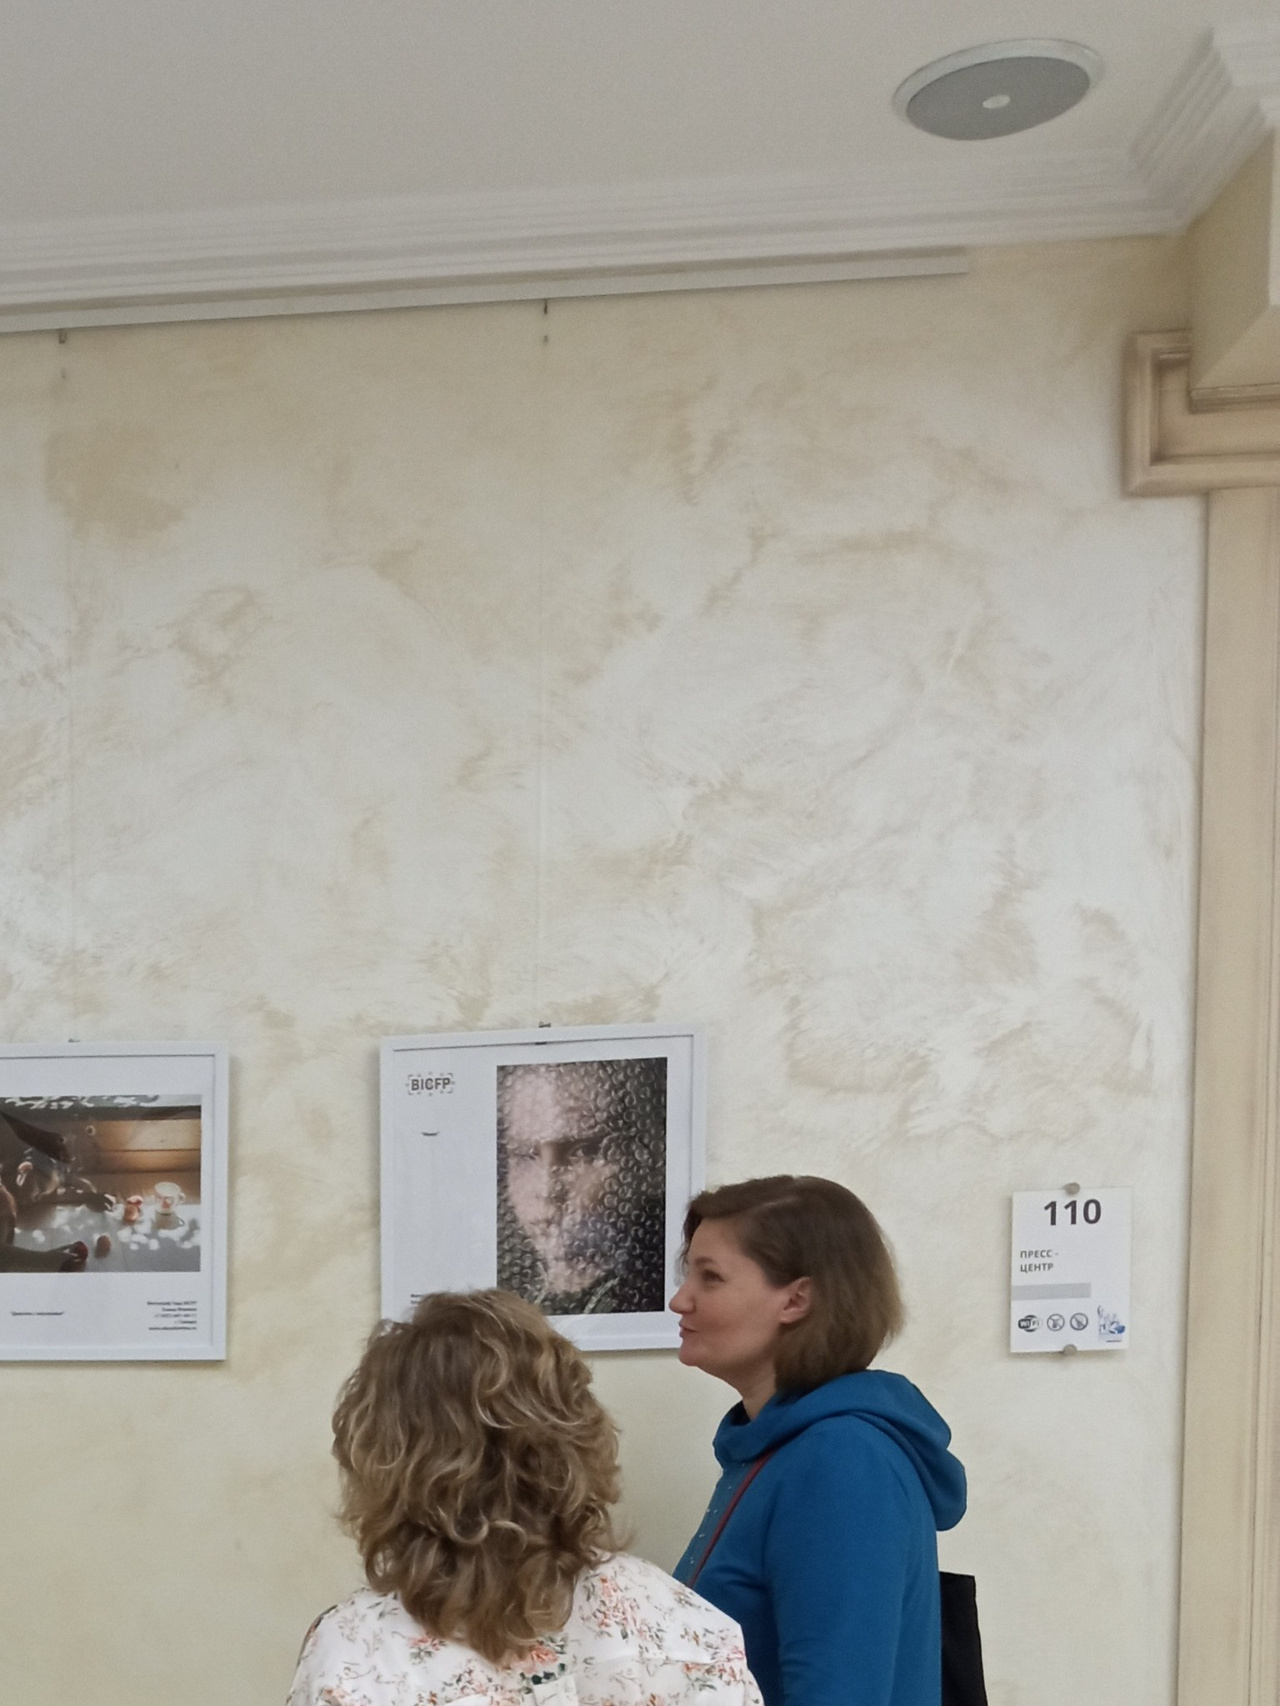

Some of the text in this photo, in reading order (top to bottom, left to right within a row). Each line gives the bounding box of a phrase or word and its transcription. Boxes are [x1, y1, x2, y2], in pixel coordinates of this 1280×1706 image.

[411, 1077, 451, 1091] BICFP
[1044, 1199, 1102, 1226] 110
[1020, 1263, 1054, 1273] ЦЕНТР
